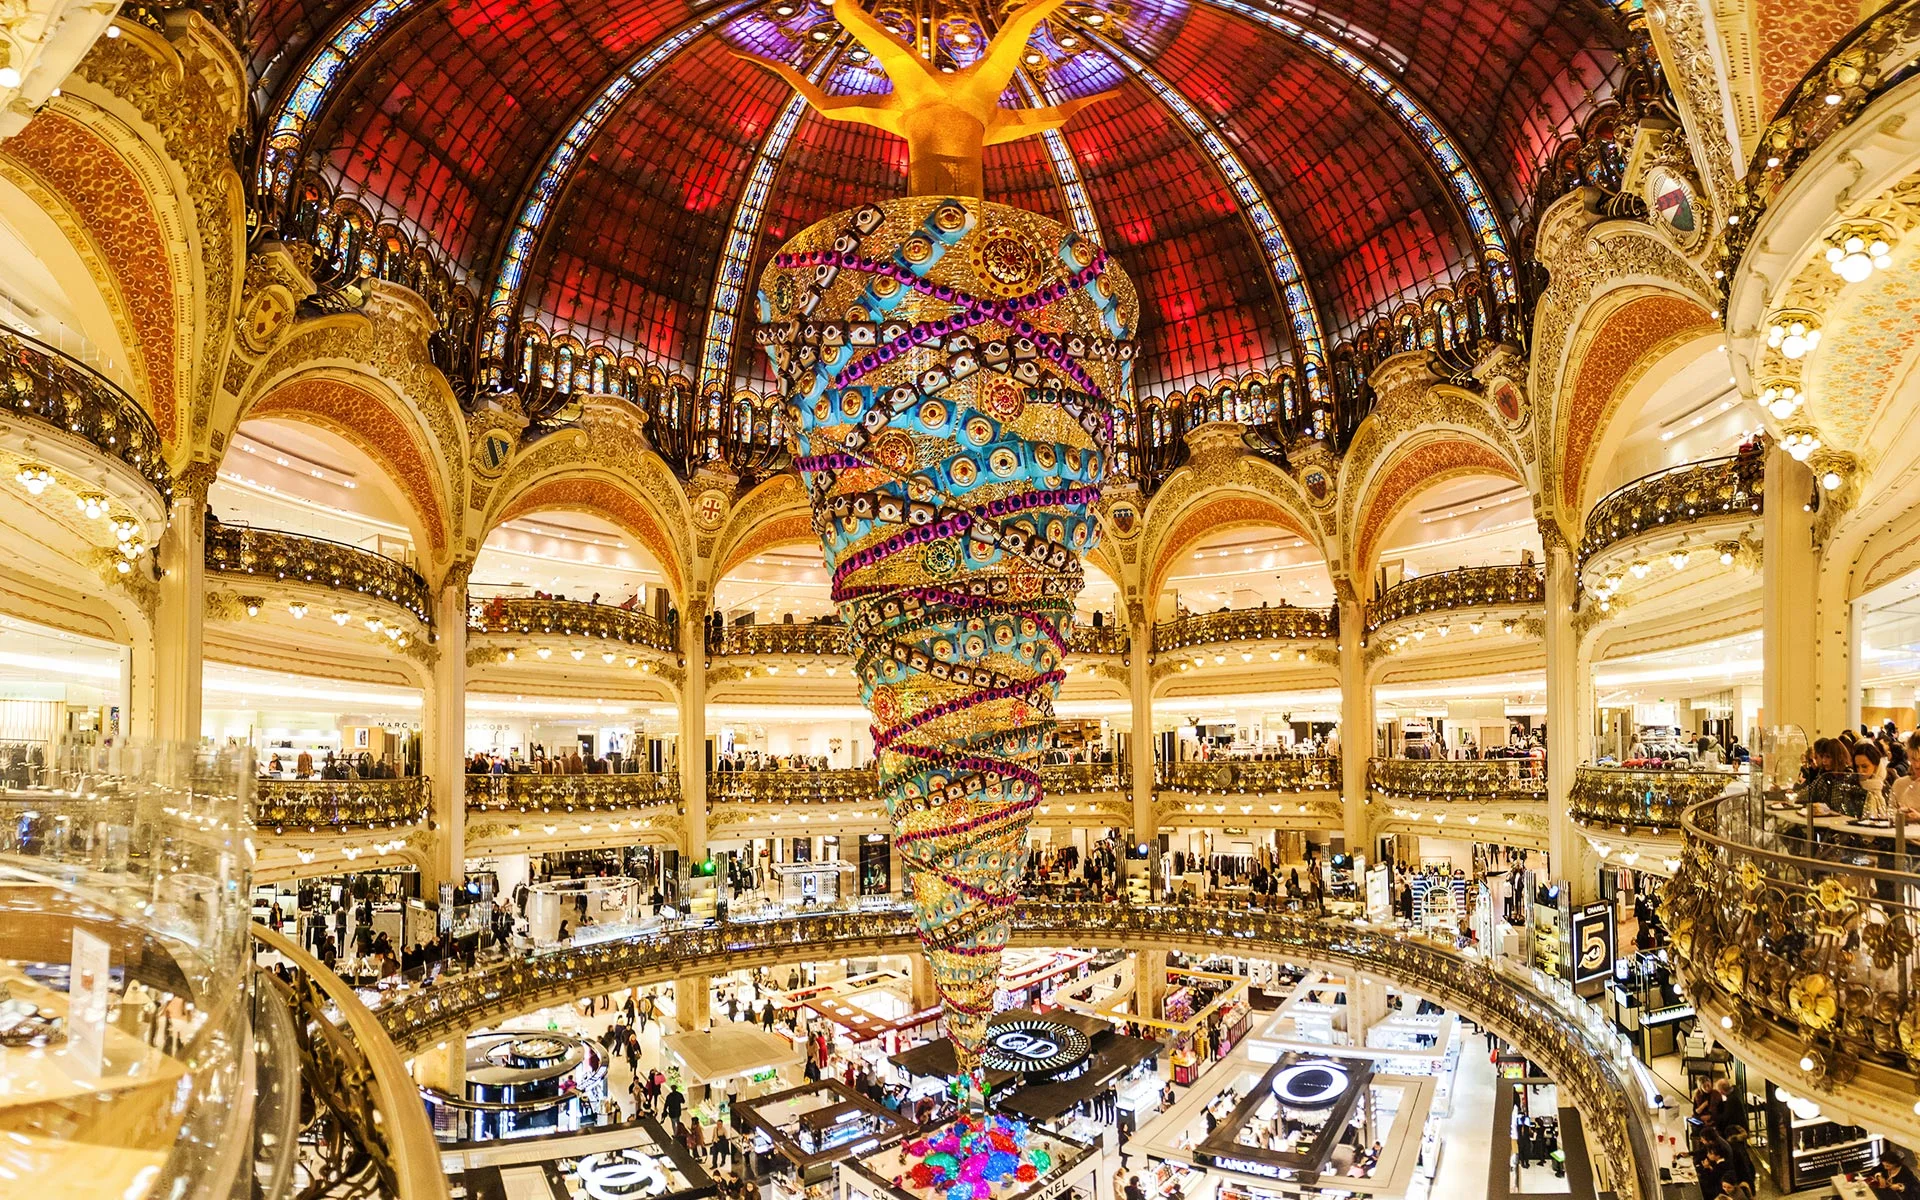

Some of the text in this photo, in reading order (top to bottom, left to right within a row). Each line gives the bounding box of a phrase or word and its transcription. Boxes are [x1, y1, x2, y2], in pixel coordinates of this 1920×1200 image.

[1582, 922, 1607, 970] 5
[1215, 1156, 1279, 1178] LANCÔME
[1032, 1179, 1069, 1200] ANEL
